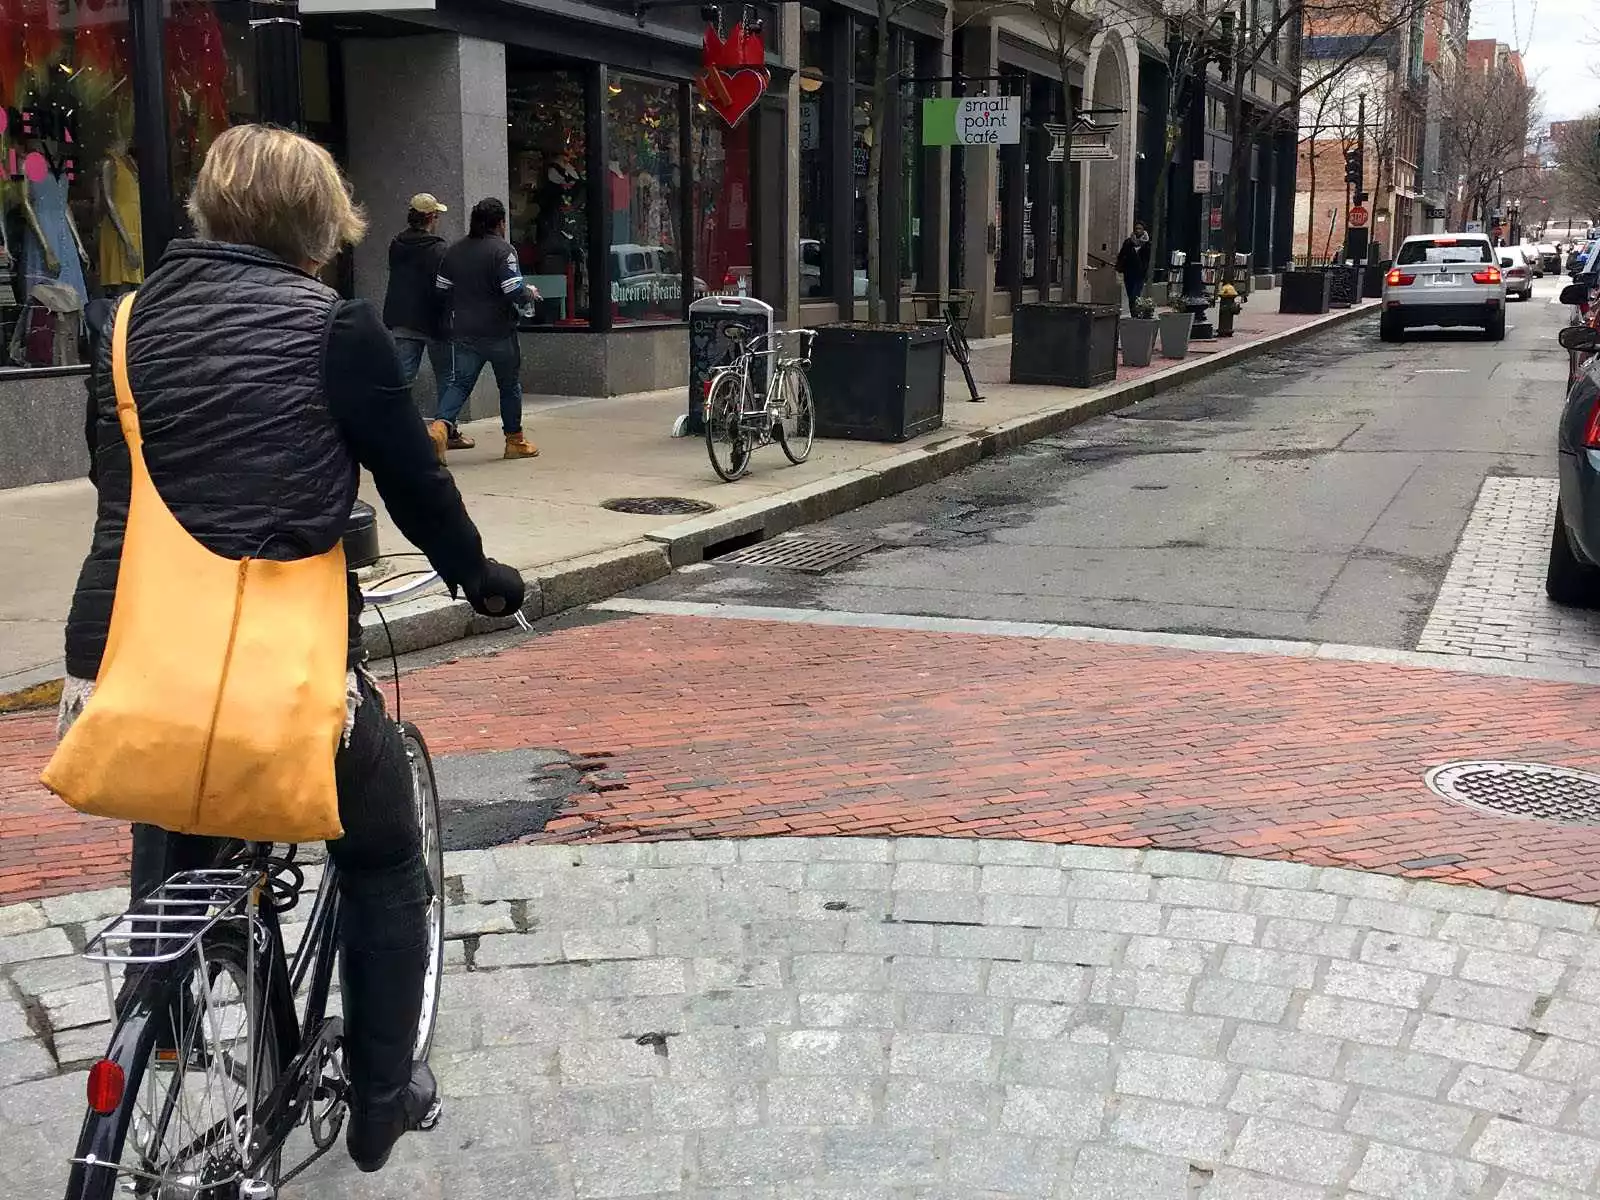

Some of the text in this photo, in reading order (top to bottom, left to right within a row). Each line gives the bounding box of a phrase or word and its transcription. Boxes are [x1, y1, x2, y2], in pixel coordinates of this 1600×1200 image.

[965, 98, 1008, 111] small
[964, 112, 1007, 134] point
[964, 130, 999, 144] café
[1350, 212, 1368, 222] STOP
[611, 280, 681, 304] Queen of Hearts
